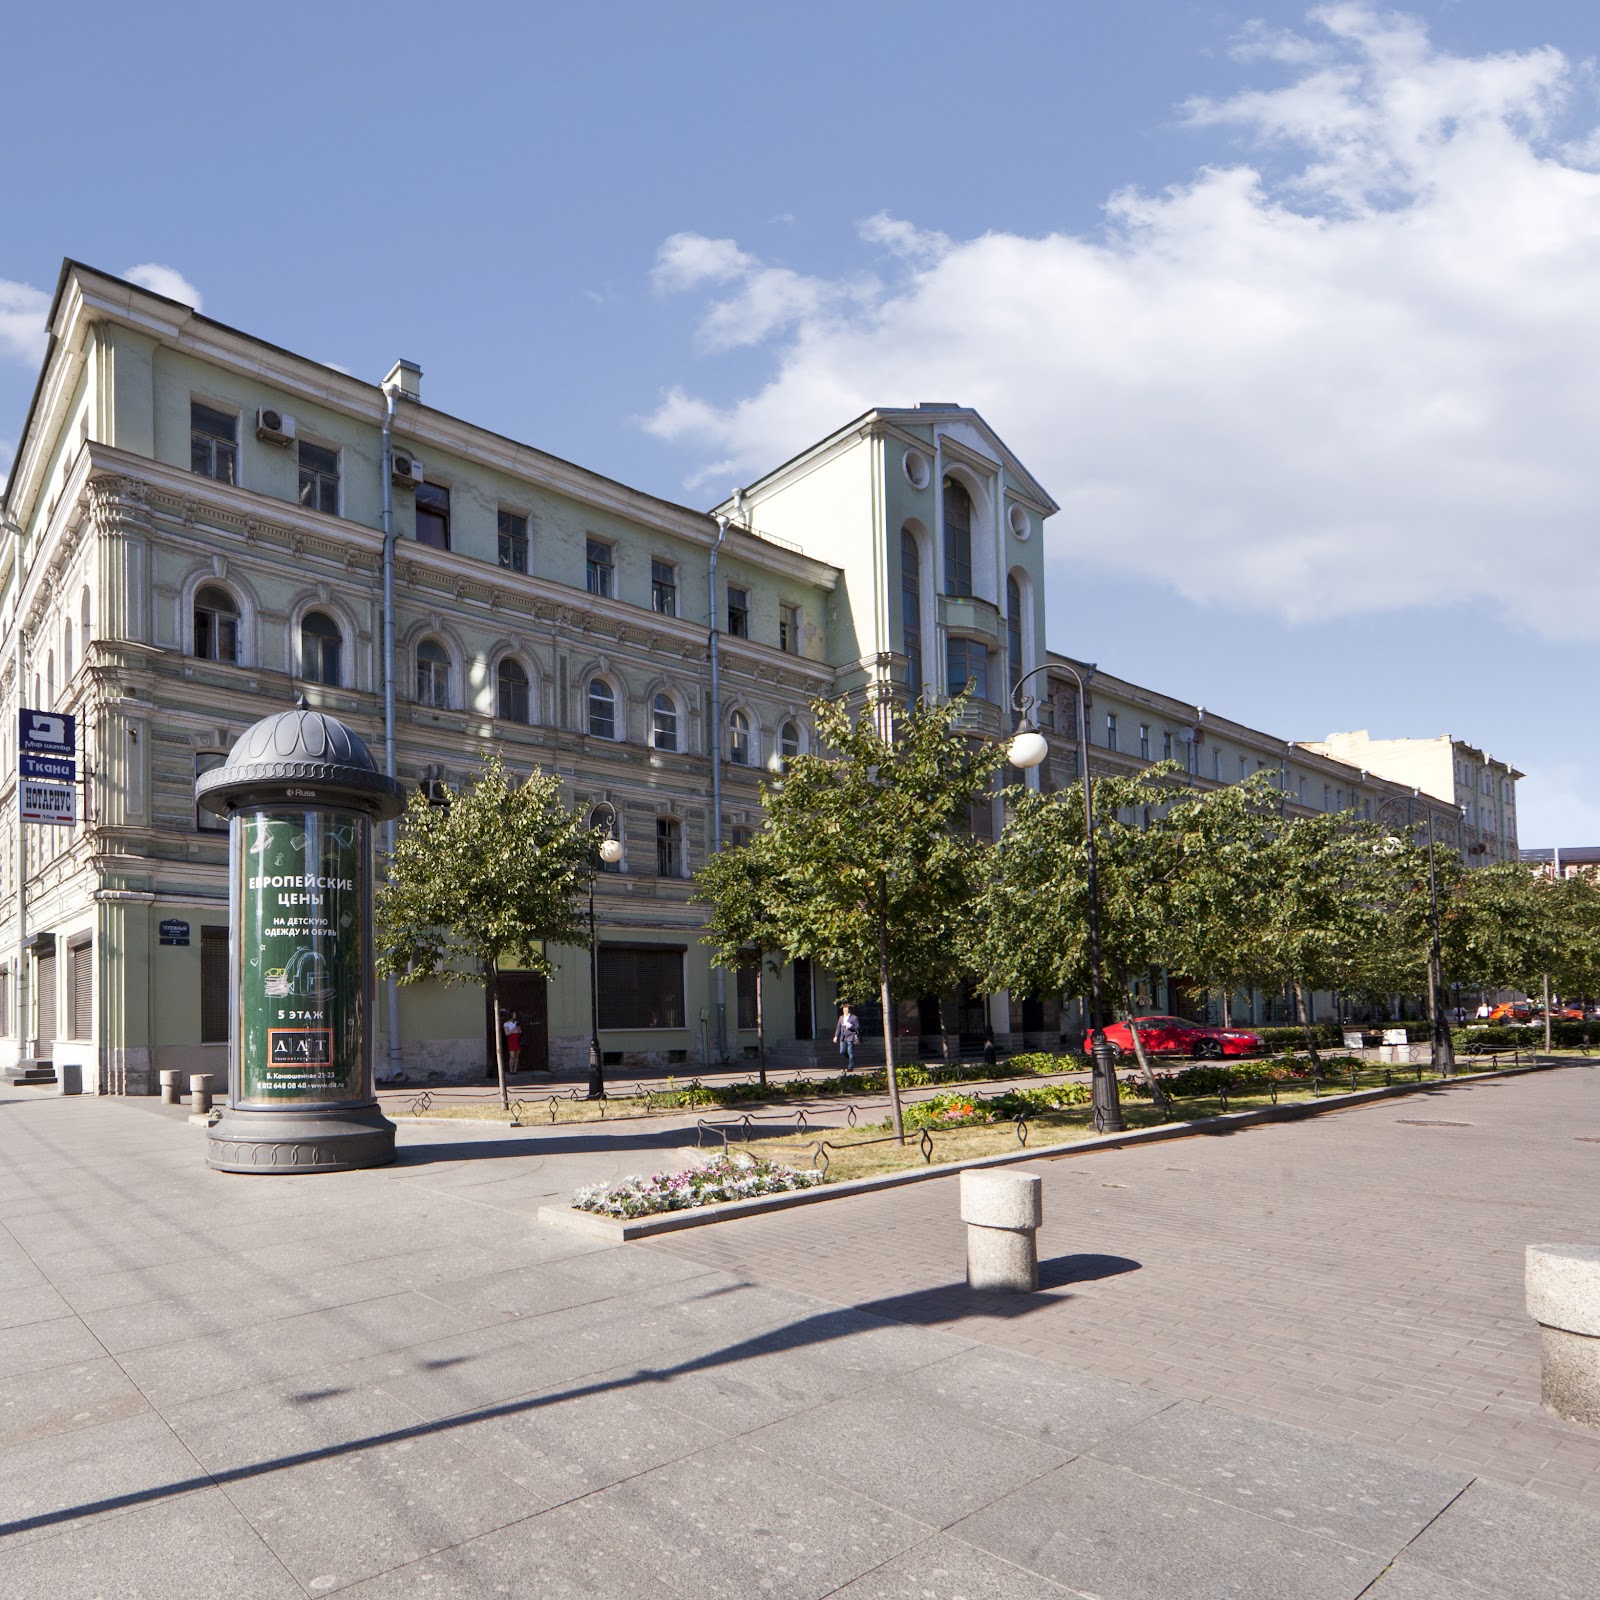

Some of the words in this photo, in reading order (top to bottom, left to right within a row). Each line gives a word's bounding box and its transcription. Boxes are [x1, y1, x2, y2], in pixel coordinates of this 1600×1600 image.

[25, 740, 43, 749] Мир
[26, 759, 70, 775] Ткани
[295, 788, 316, 797] Russ
[26, 787, 71, 812] НОТАРИУС
[249, 873, 353, 891] ЕВРОПЕЙСКИЕ
[278, 893, 324, 907] ЦЕНЫ
[273, 917, 285, 925] НА
[287, 917, 328, 926] ДЕТСКУЮ
[264, 928, 300, 937] ОДЕЖДУ
[311, 928, 337, 937] ОБУВЬ
[277, 1010, 285, 1020] 5
[288, 1010, 324, 1020] ЭТАЖ
[318, 1071, 335, 1079] 21-23
[273, 1082, 286, 1090] 648
[287, 1082, 296, 1090] 08
